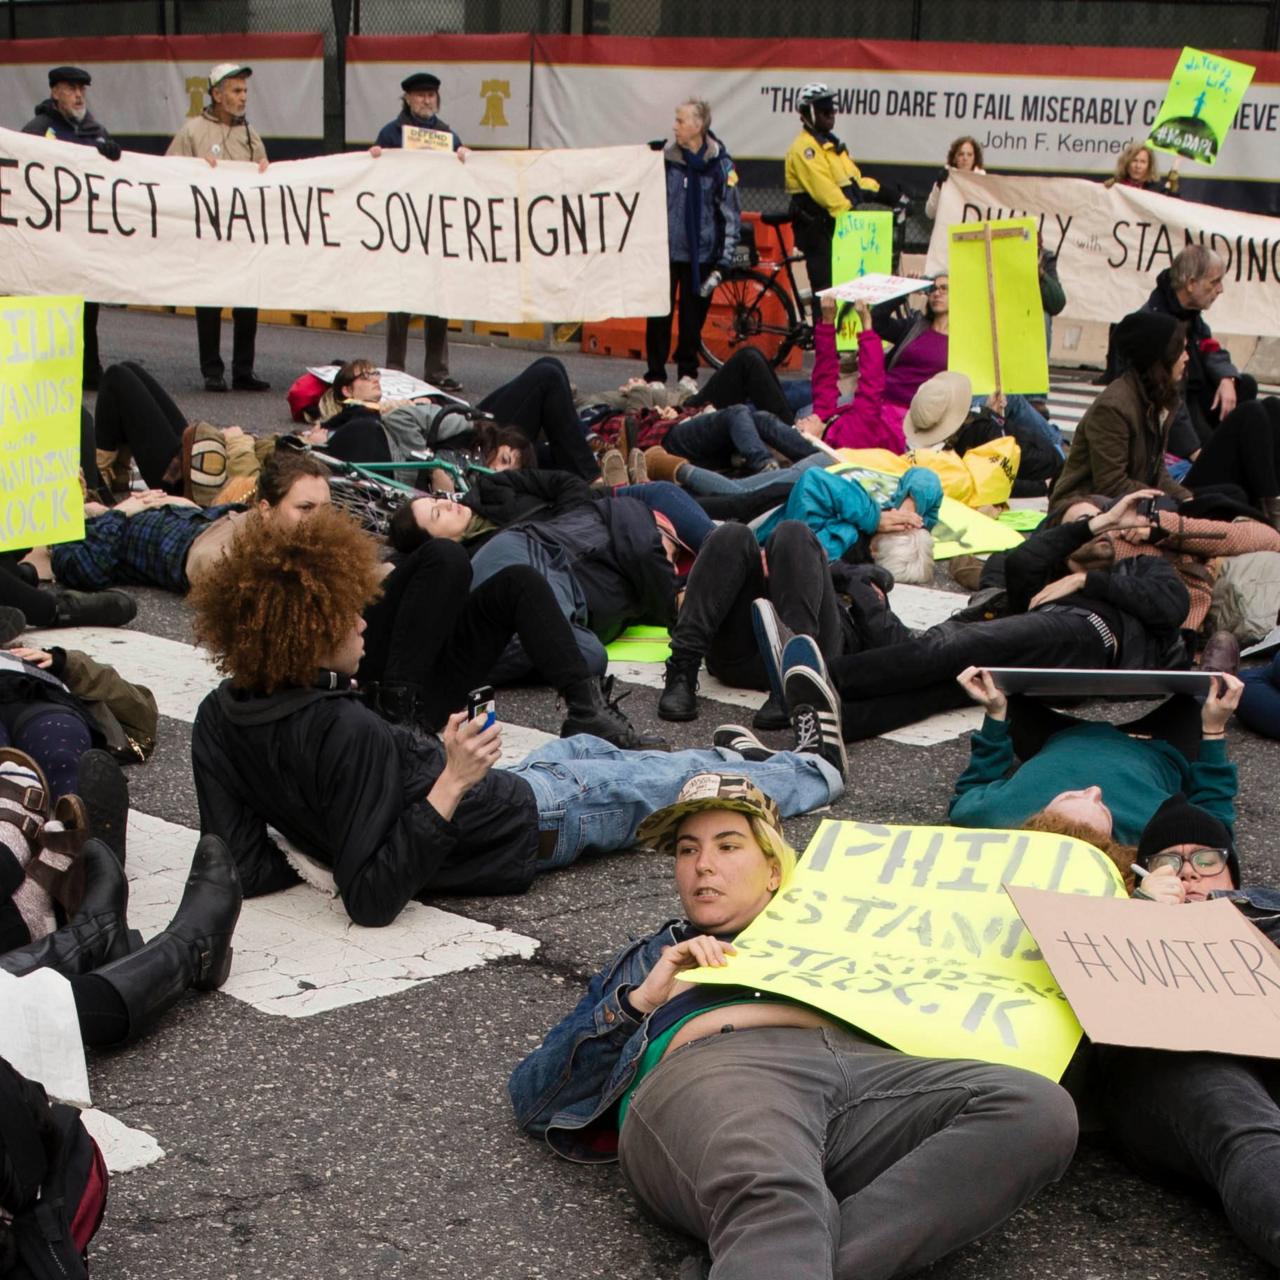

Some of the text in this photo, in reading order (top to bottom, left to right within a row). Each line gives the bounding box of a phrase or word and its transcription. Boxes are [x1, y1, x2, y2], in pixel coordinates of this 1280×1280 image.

[838, 87, 881, 116] WHO
[886, 90, 938, 118] DARE
[944, 92, 968, 119] TO
[973, 93, 1015, 121] FAIL
[1021, 95, 1138, 126] MISERABLY
[981, 131, 1134, 154] John F. Kenned
[190, 184, 341, 247] NATIVE
[356, 191, 640, 263] SOVEREIGNTY
[761, 971, 1036, 1049] ROCK
